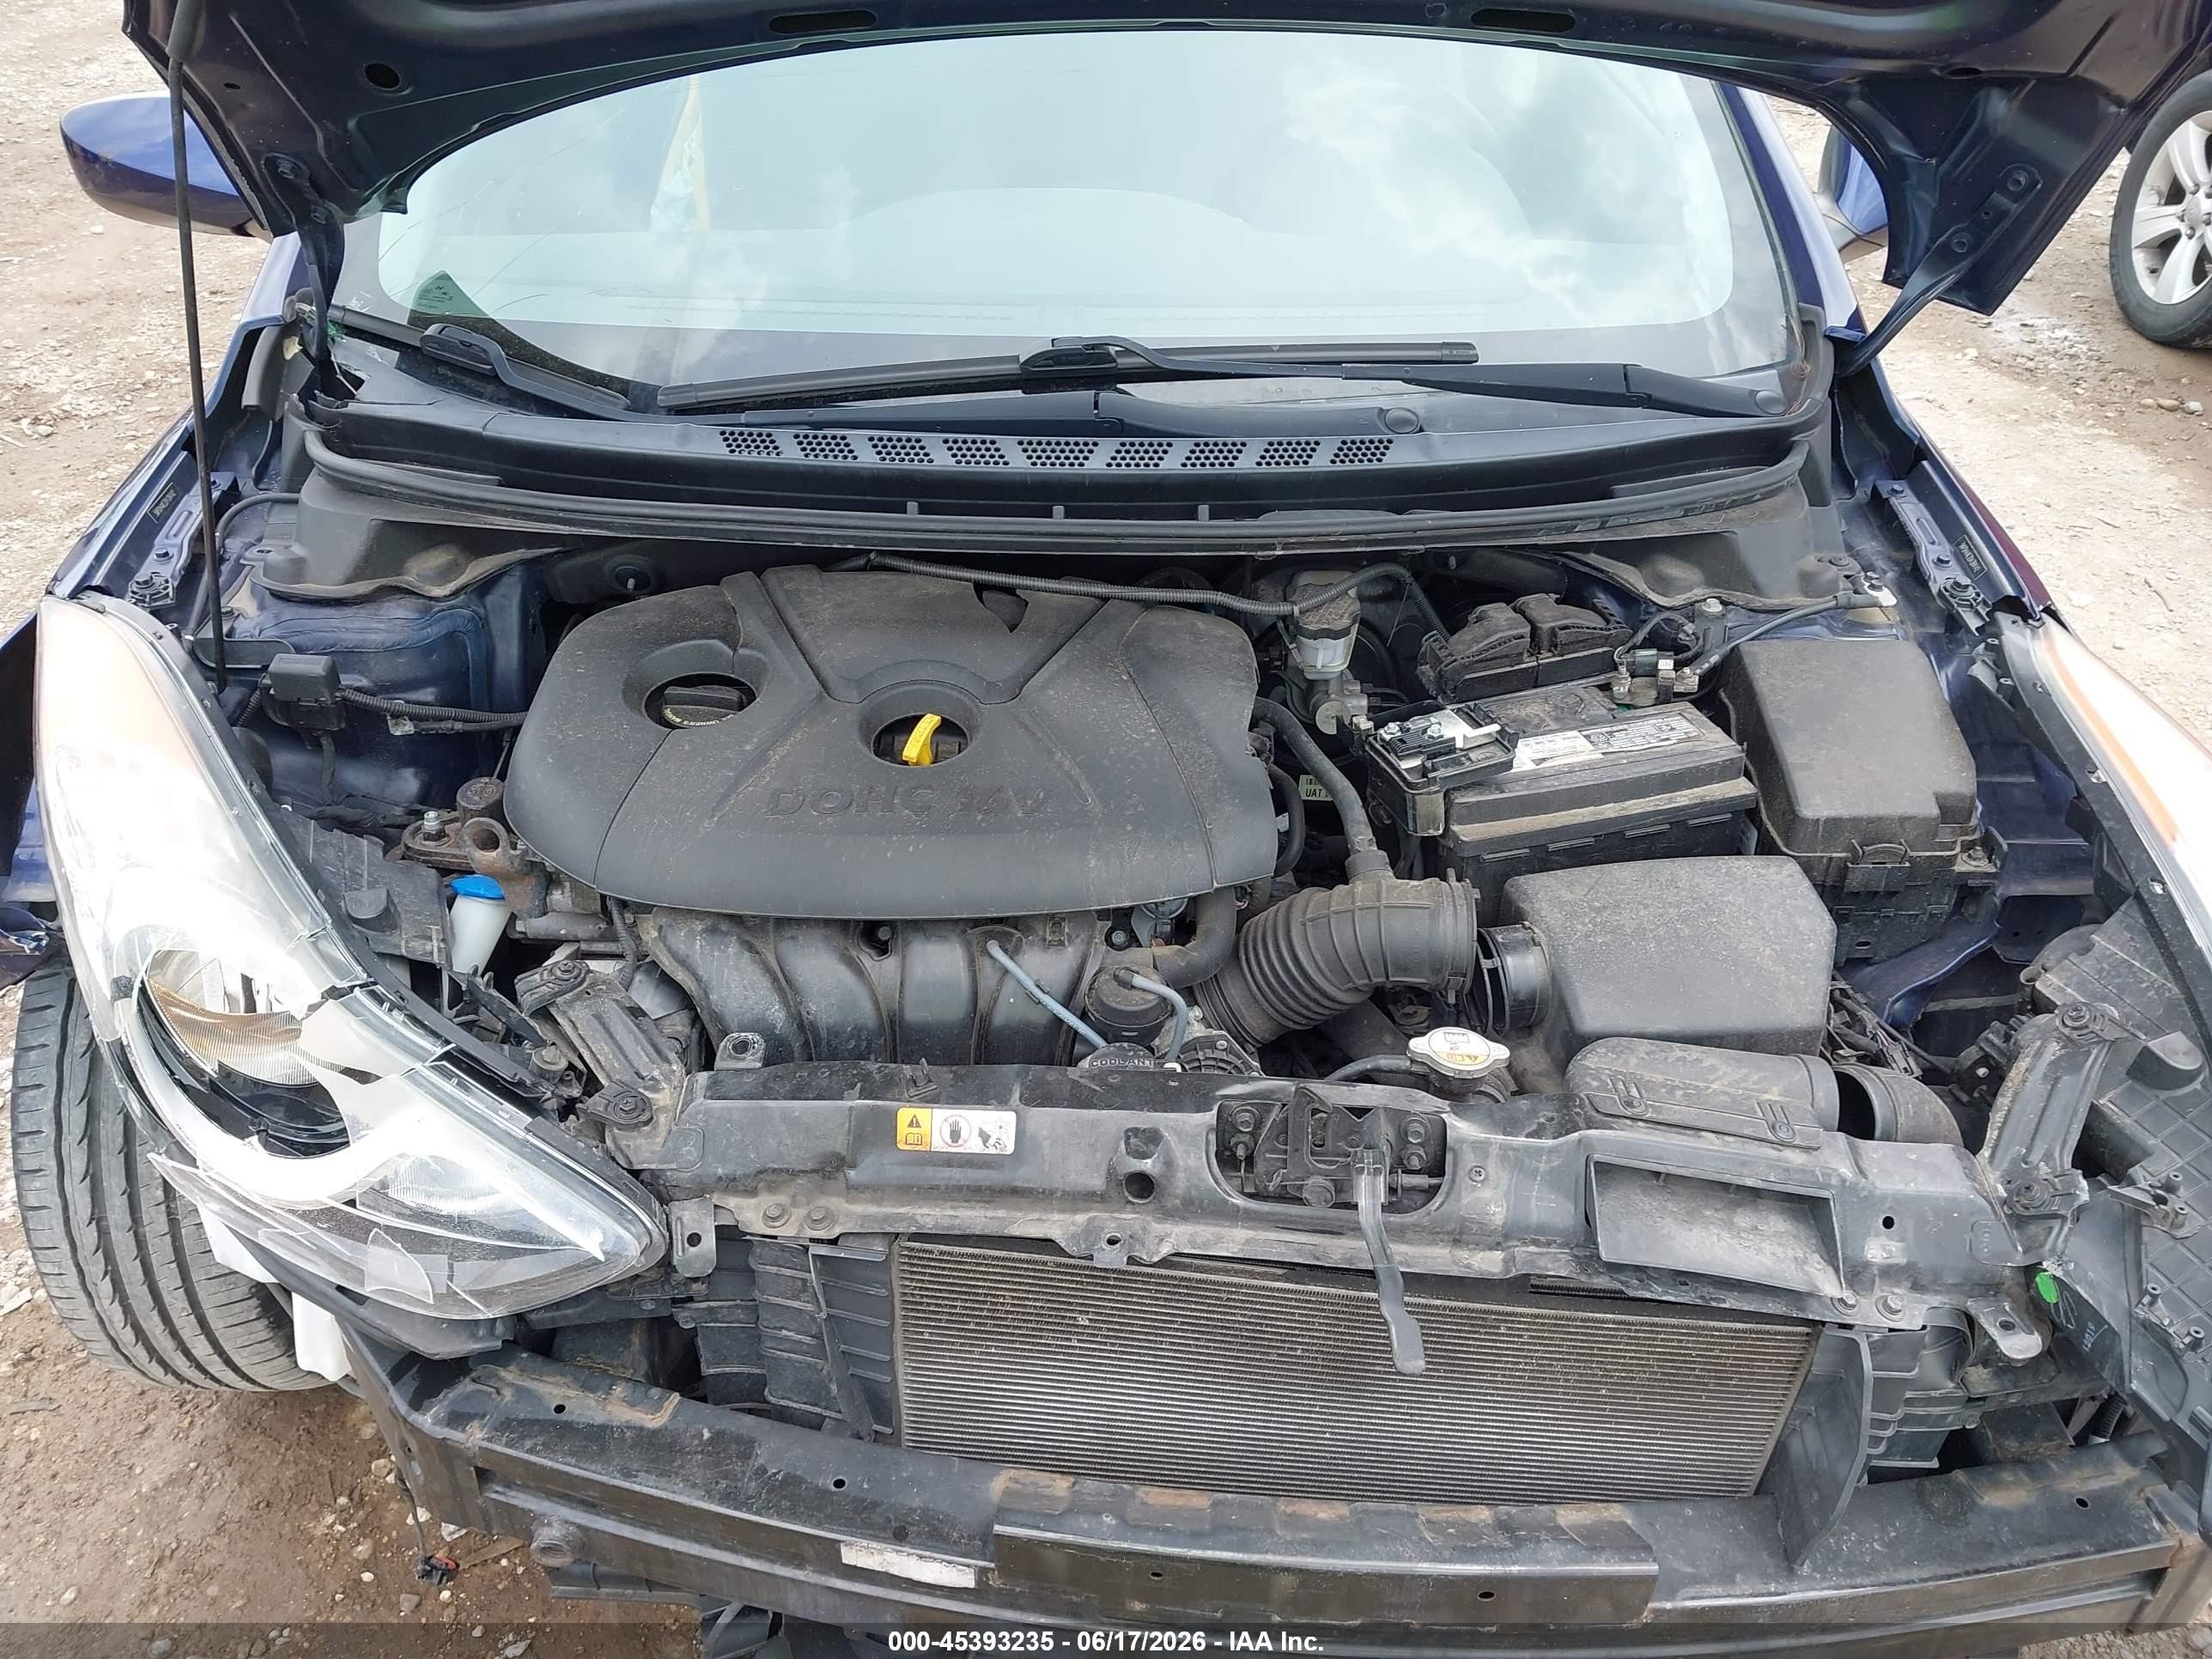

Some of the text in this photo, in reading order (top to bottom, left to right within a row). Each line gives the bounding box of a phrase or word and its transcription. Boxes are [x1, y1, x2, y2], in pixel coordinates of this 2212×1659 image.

[1305, 787, 1323, 798] UAT
[765, 784, 933, 817] DOHC
[1091, 1057, 1156, 1068] COOLANT
